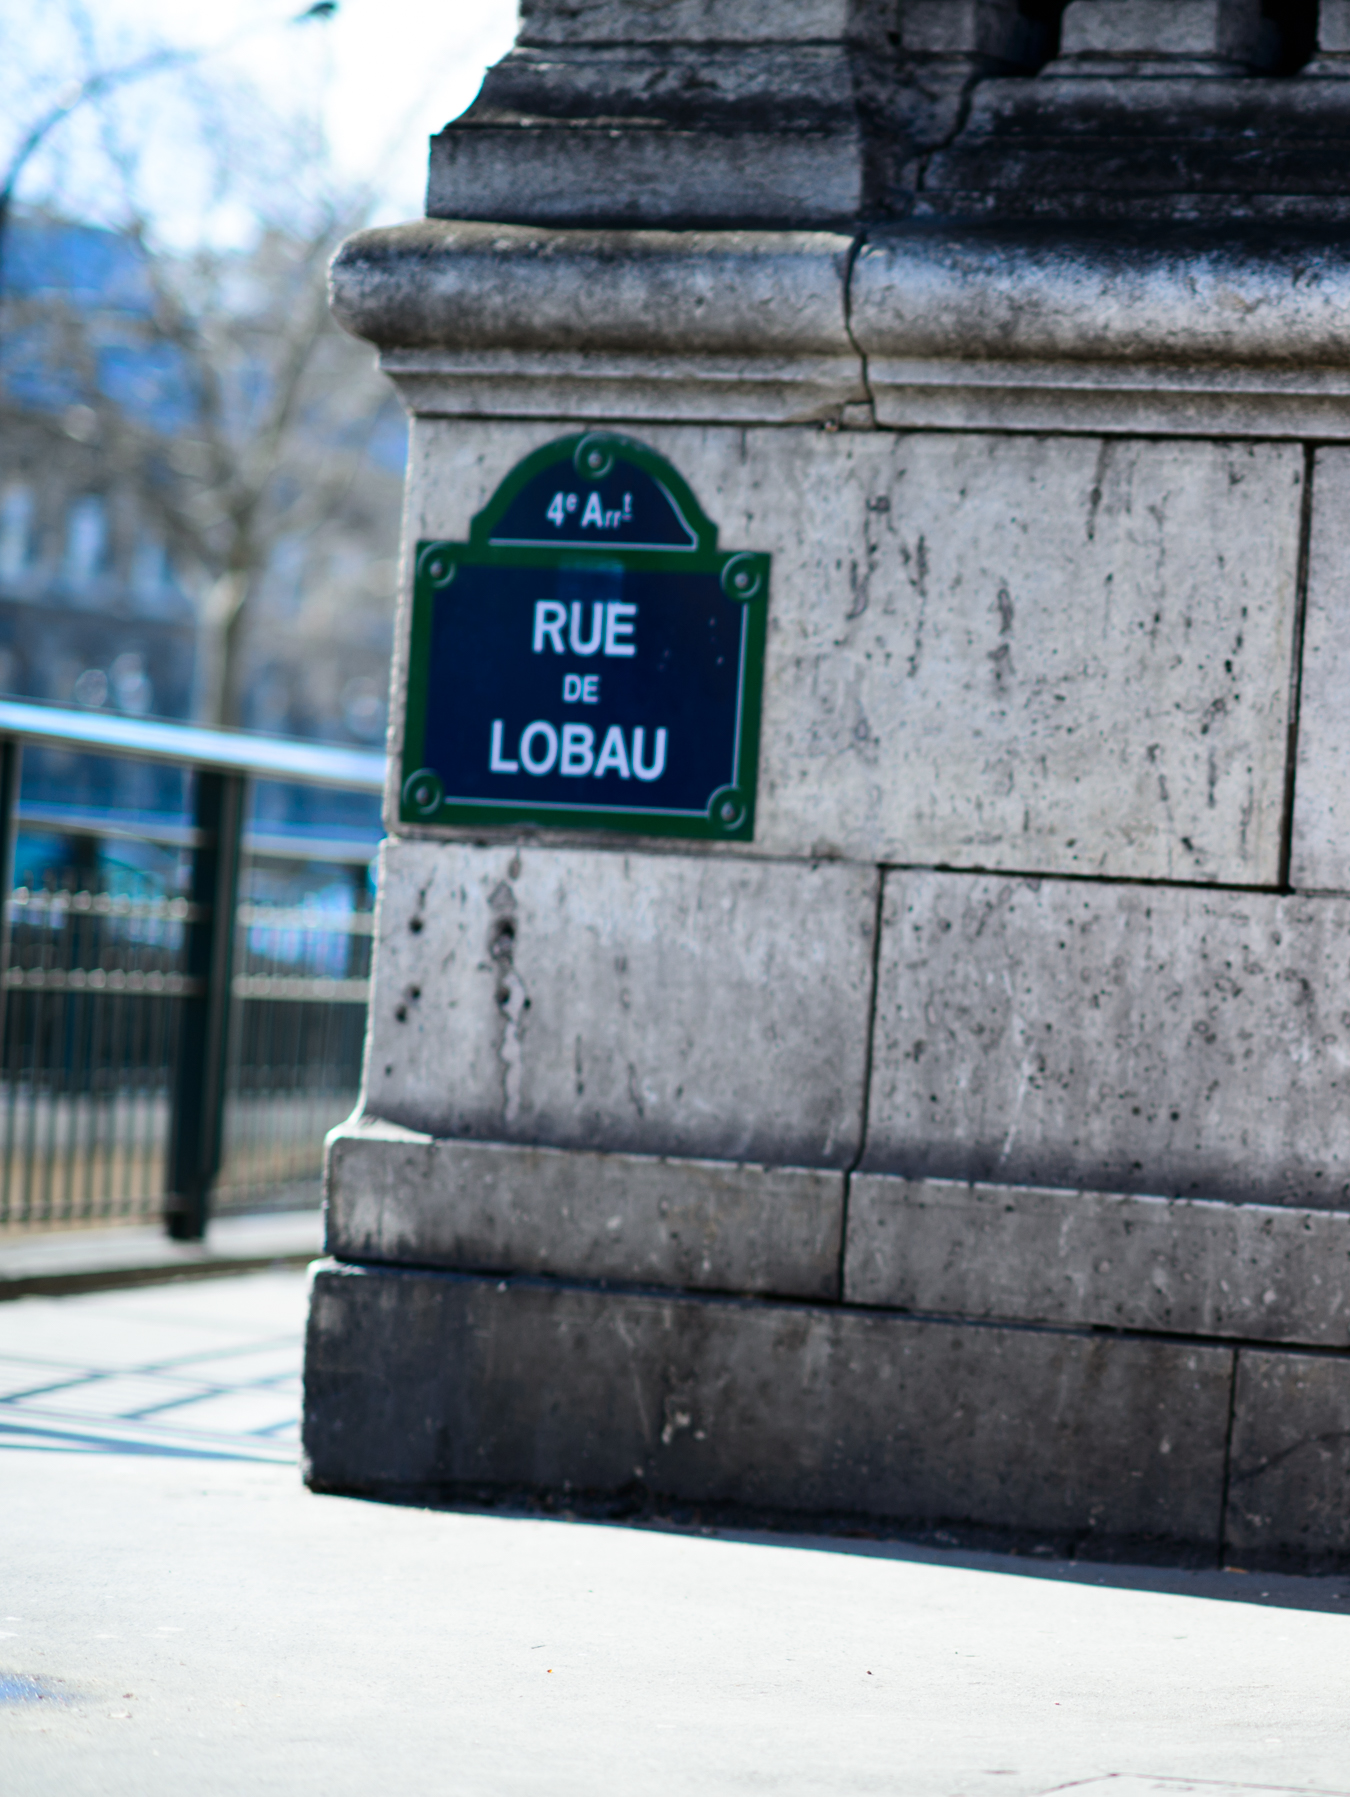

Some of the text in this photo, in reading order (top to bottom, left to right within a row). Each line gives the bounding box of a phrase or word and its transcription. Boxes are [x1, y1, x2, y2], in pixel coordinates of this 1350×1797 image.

[532, 600, 637, 657] RUE
[563, 674, 599, 704] DE
[489, 719, 667, 781] LOBAU
